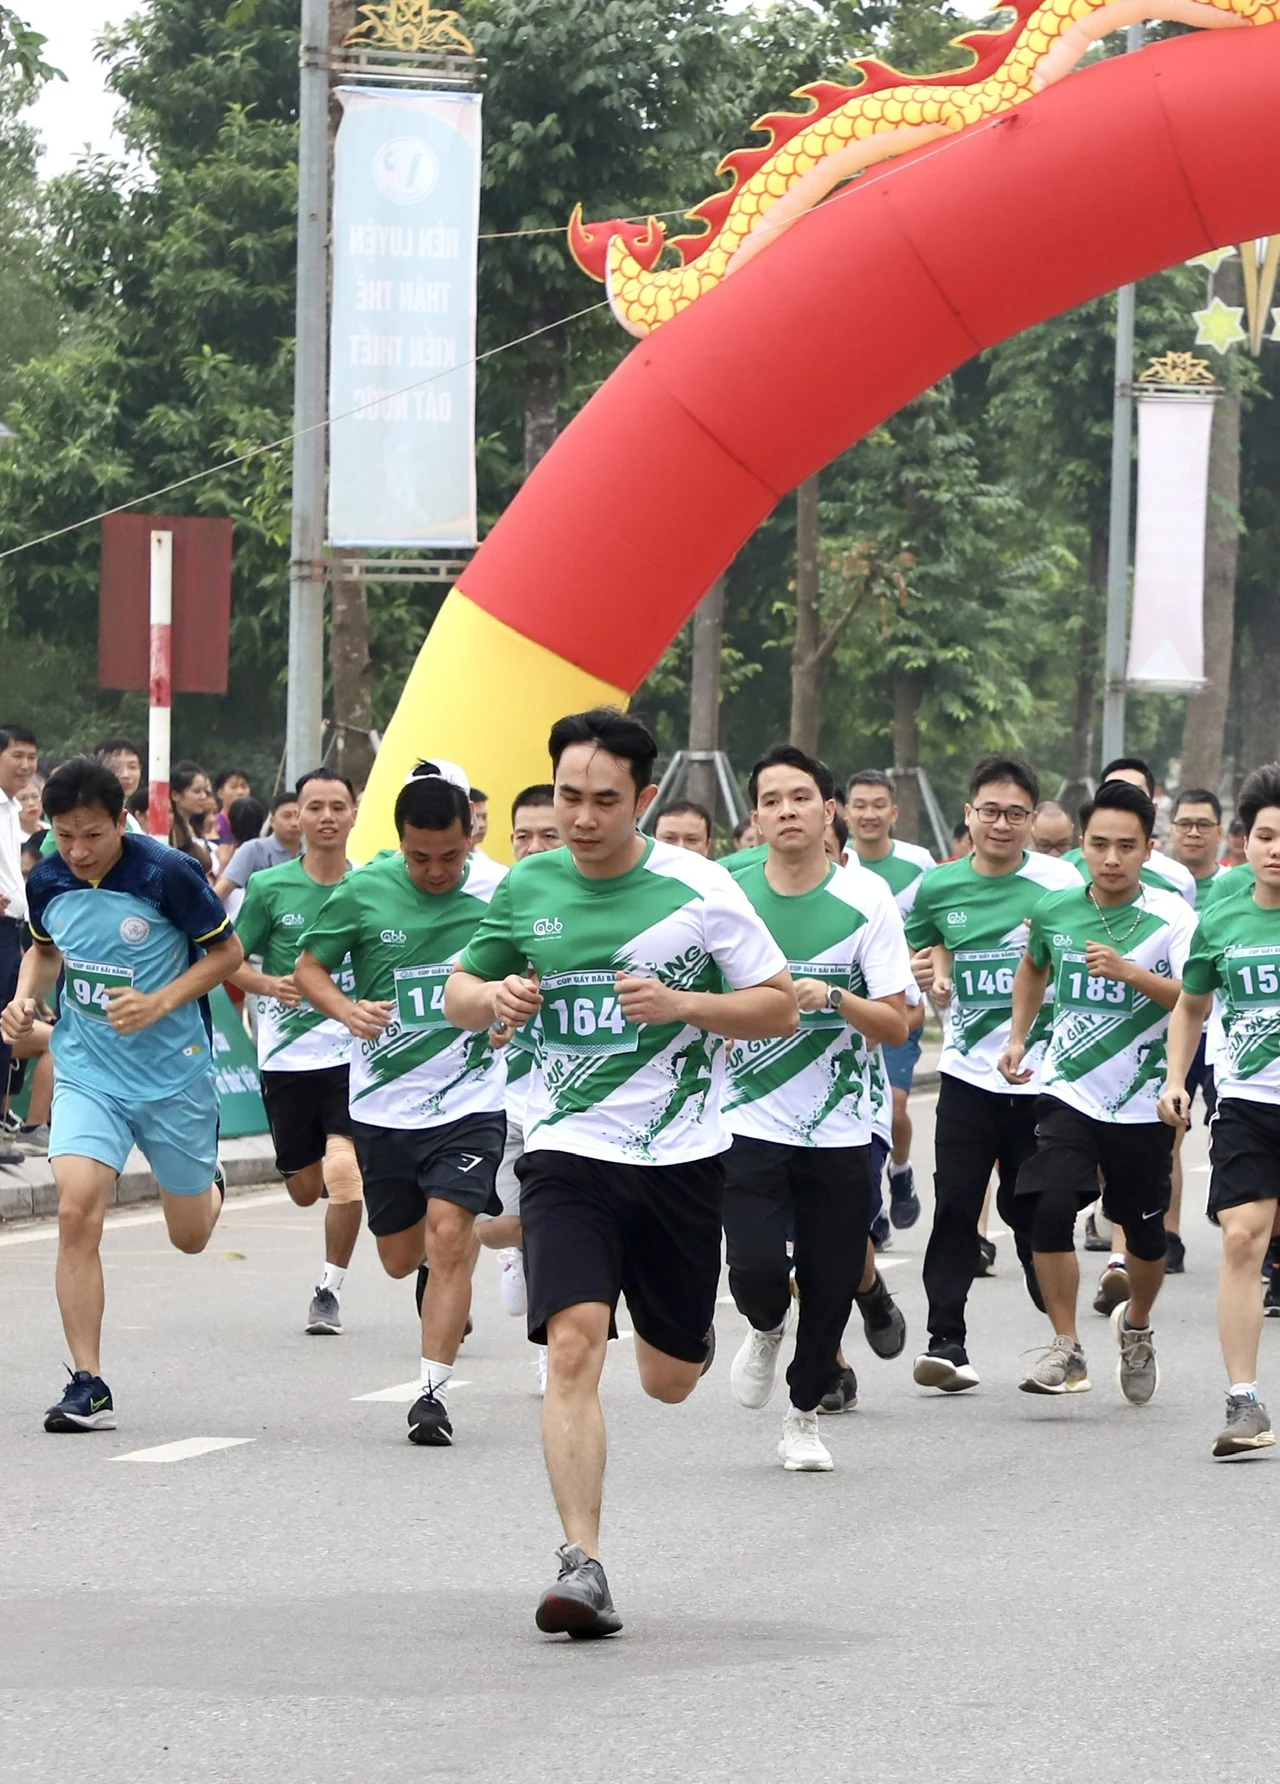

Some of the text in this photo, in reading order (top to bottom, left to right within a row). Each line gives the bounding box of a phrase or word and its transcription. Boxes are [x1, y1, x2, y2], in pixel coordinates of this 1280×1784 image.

[73, 979, 110, 1010] 94
[961, 968, 1014, 995] 146
[1069, 972, 1126, 1003] 183
[549, 997, 626, 1036] 164
